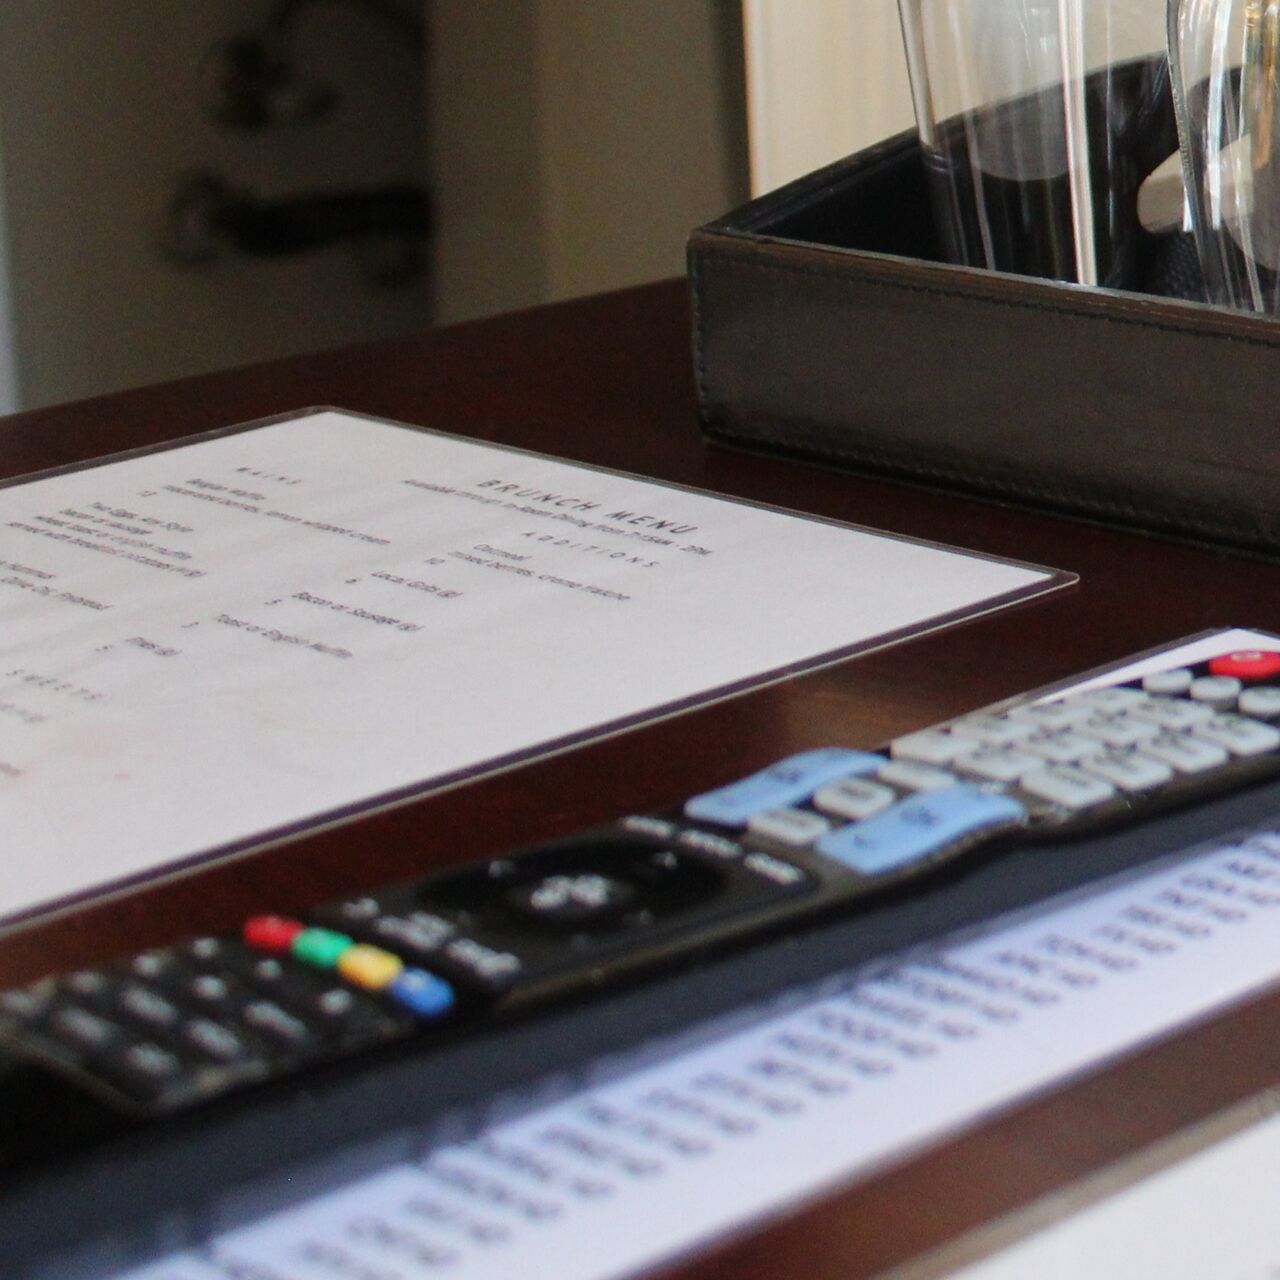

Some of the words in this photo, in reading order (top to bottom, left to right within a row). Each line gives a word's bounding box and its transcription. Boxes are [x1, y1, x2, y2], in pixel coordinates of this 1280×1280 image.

[474, 478, 603, 511] BRUNCH
[603, 509, 699, 534] MENU
[520, 531, 661, 567] ADDITIONS
